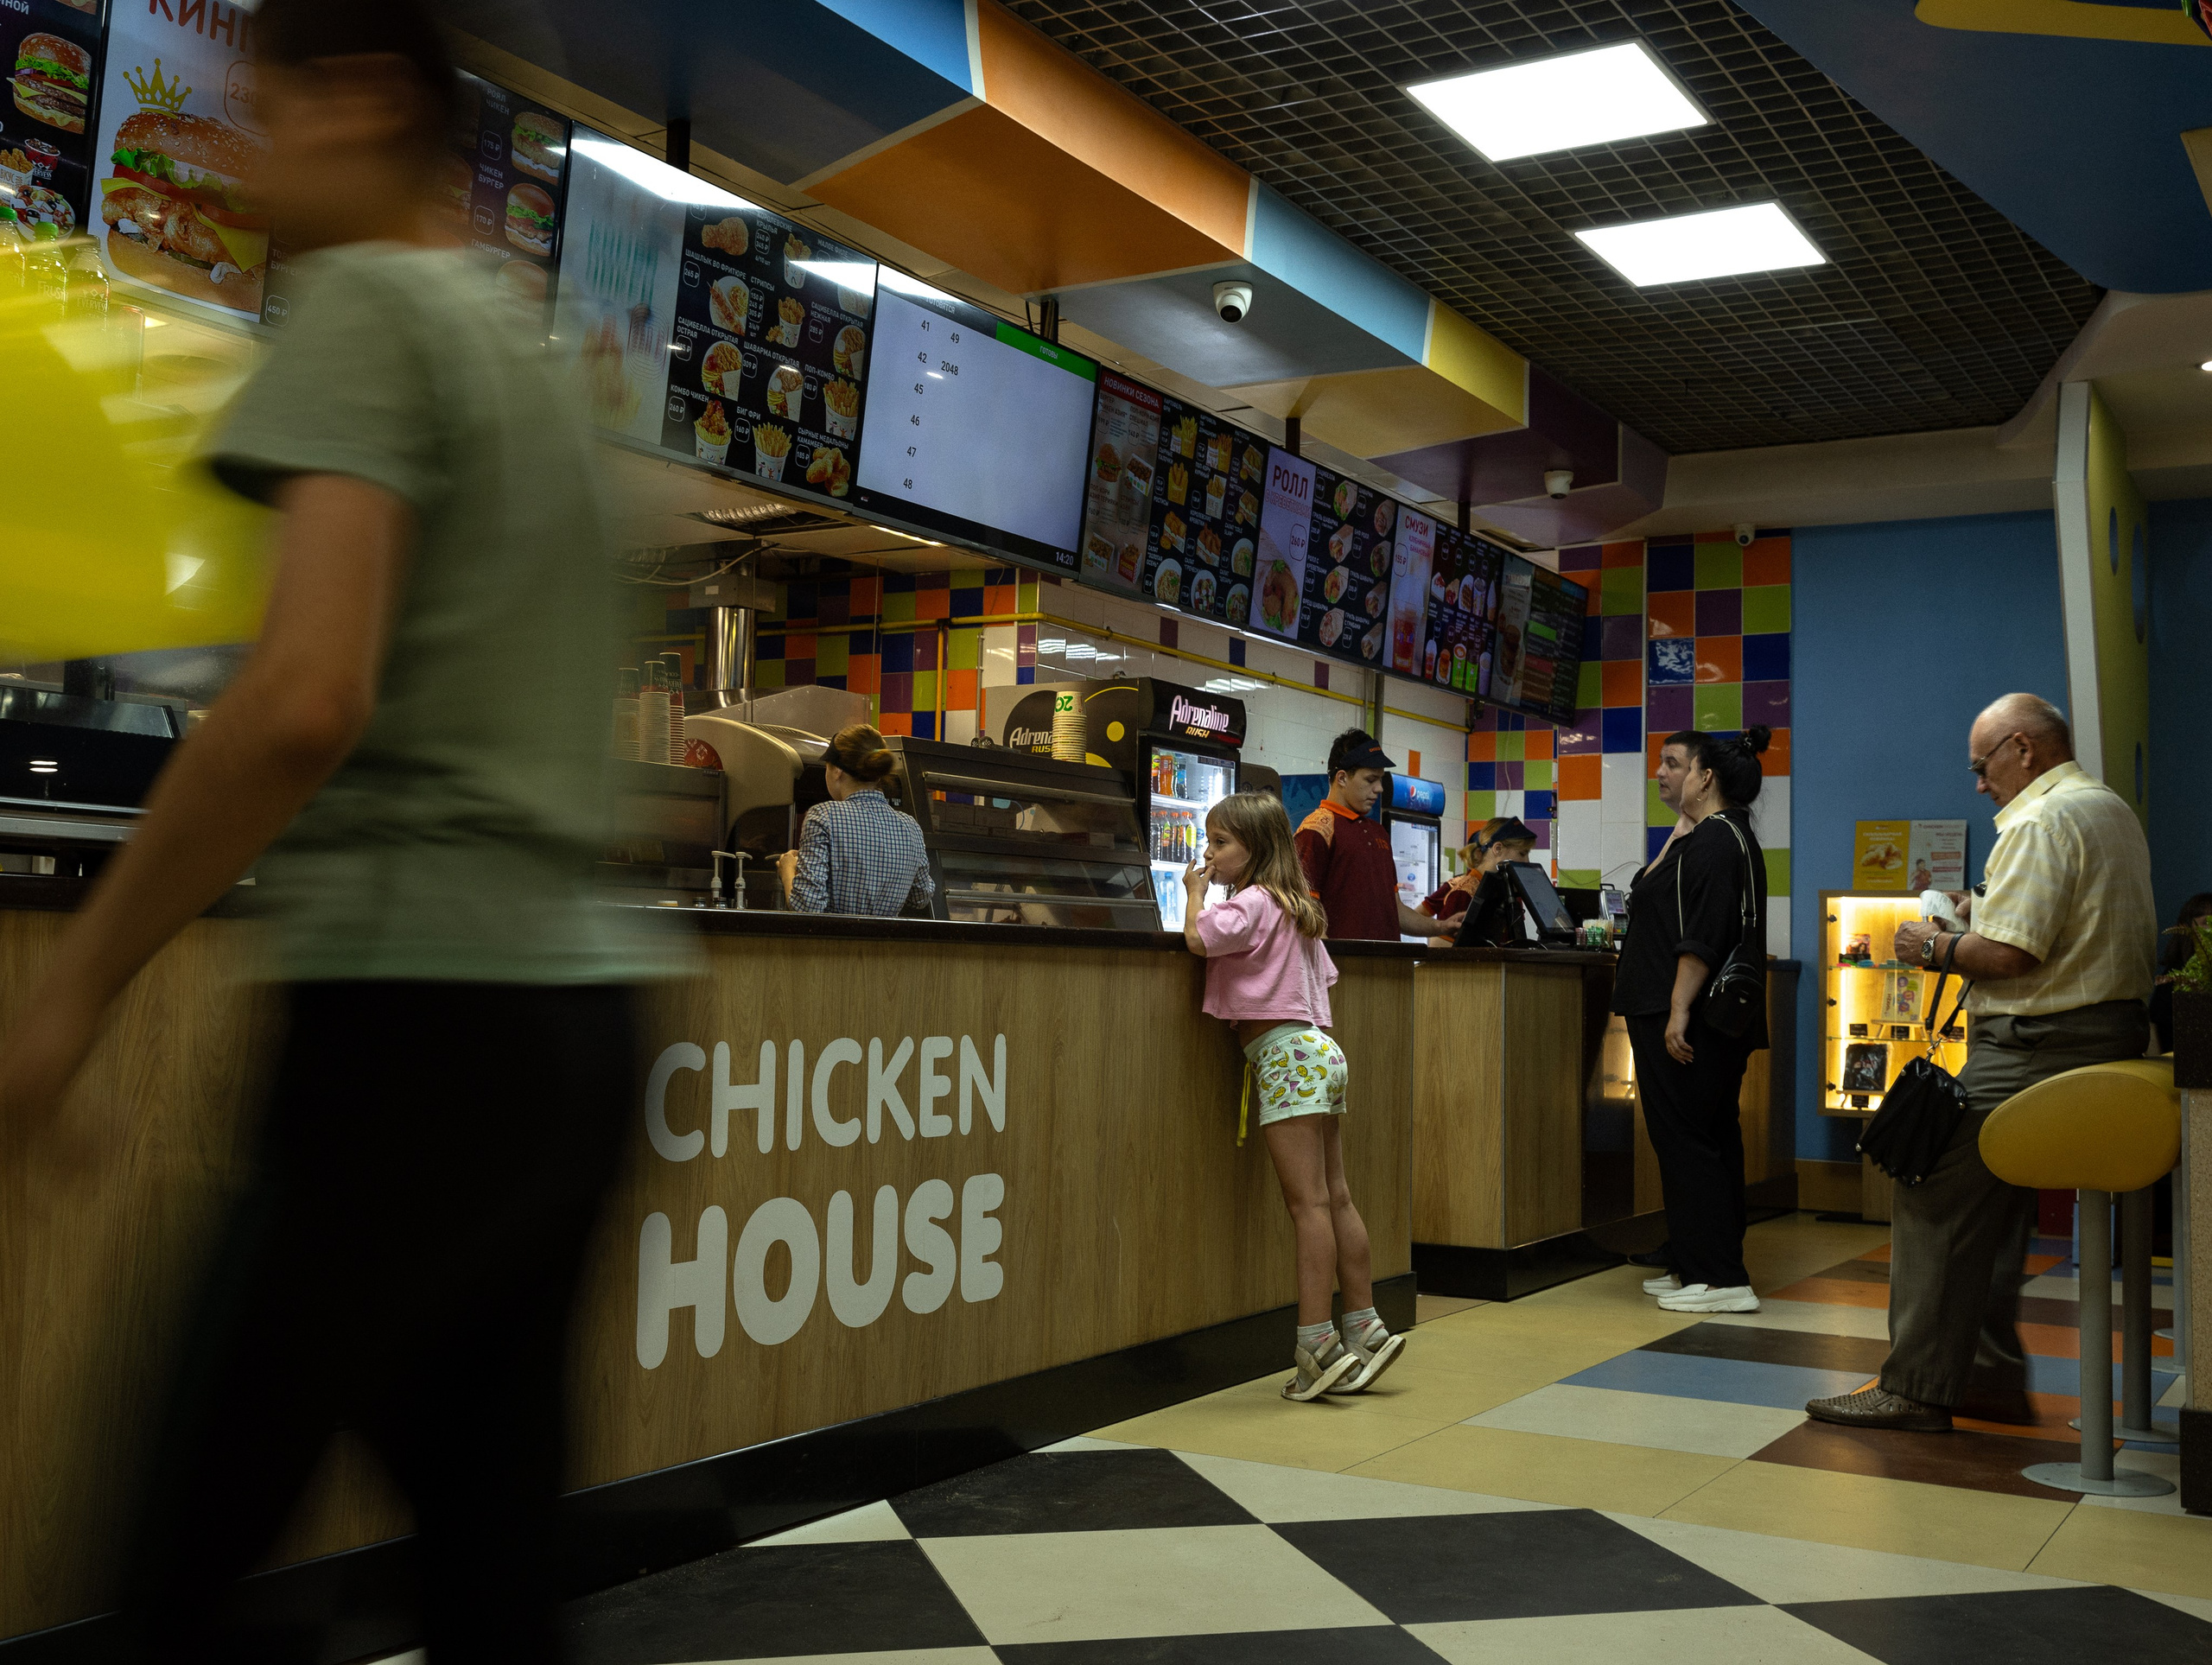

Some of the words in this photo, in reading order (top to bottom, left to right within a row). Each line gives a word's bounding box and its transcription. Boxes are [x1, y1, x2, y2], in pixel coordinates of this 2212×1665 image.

[487, 89, 506, 102] РОЯЛ
[486, 99, 511, 116] ЧИКЕН
[483, 138, 495, 150] 175
[33, 168, 53, 179] ERVESS
[480, 162, 504, 180] ЧИКЕН
[479, 173, 505, 190] БУРГЕР
[475, 214, 487, 226] 170
[756, 219, 779, 235] КРЫЛЬЯ
[471, 239, 511, 259] ГАМБУРГЕР
[685, 248, 712, 266] ШАШЛЫК
[713, 258, 721, 269] ВО
[721, 261, 747, 280] ФРИТЮРЕ
[684, 267, 695, 278] 265
[750, 276, 775, 292] СТРИПСЫ
[267, 305, 281, 315] 450
[749, 300, 758, 310] 245
[810, 309, 831, 324] НЕЖНАЯ
[811, 301, 839, 318] САЦИБЕЛЛА
[839, 311, 864, 327] ОТКРЫТАЯ
[677, 316, 710, 336] САЦИБЕЛЛА
[711, 328, 739, 346] ОТКРЫТАЯ
[677, 325, 698, 340] ОСТРАЯ
[921, 320, 931, 333] 41
[950, 332, 960, 344] 49
[743, 340, 772, 359] ШАВАРМА
[772, 351, 800, 369] ОТКРЫТАЯ
[918, 352, 927, 364] 42
[1039, 345, 1058, 361] ГОТОВЫ
[742, 359, 753, 368] 309
[941, 360, 959, 377] 2048
[804, 363, 836, 381] ПОП-КОМБО
[804, 381, 812, 391] 180
[914, 383, 924, 395] 45
[1103, 376, 1135, 399] НОВИНКИ
[1135, 387, 1160, 410] СЕЗОНА
[671, 384, 690, 398] КОМБО
[690, 390, 709, 404] ЧИКЕН
[669, 402, 679, 412] 260
[736, 405, 746, 416] БИГ
[747, 410, 761, 422] ФРИ
[910, 414, 920, 427] 46
[736, 424, 745, 435] 160
[798, 427, 821, 441] СЫРНЫЕ
[821, 433, 849, 450] МЕДАЛЬОНЫ
[797, 450, 805, 460] 185
[906, 447, 917, 458] 47
[903, 479, 913, 490] 48
[1272, 466, 1309, 500] РОЛЛ
[1405, 515, 1429, 537] СМУЗИ
[1291, 535, 1301, 548] 260
[1055, 551, 1074, 567] 14:20
[1169, 695, 1230, 733] Adrenaline
[1008, 727, 1053, 748] Adrena
[1185, 726, 1211, 739] RUSH
[1031, 745, 1053, 753] RUS
[1416, 789, 1430, 801] pepsi
[645, 1033, 1007, 1162] CHICKEN
[636, 1172, 1005, 1370] HOUSE
